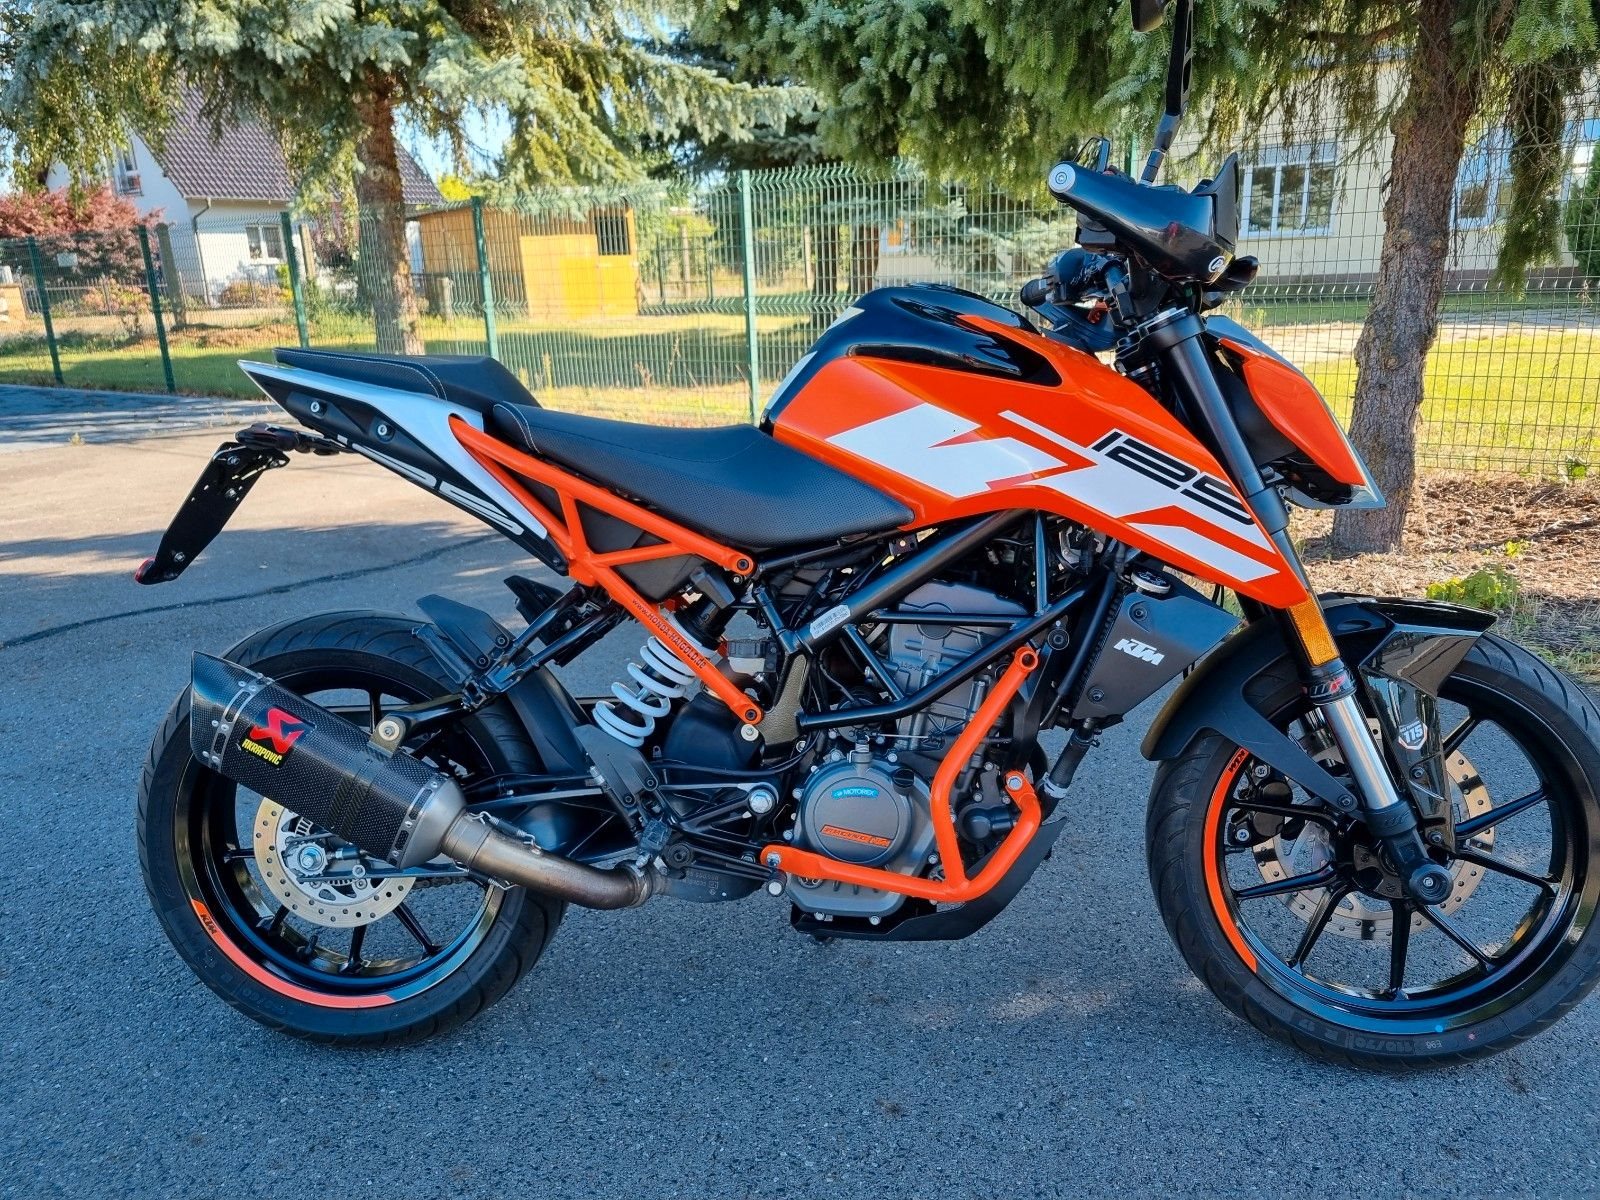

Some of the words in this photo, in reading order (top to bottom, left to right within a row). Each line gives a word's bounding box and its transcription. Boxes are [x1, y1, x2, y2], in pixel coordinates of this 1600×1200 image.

[337, 434, 525, 536] 125
[1091, 431, 1255, 526] 125
[1113, 638, 1165, 666] KTM
[843, 788, 875, 796] MOTOREX
